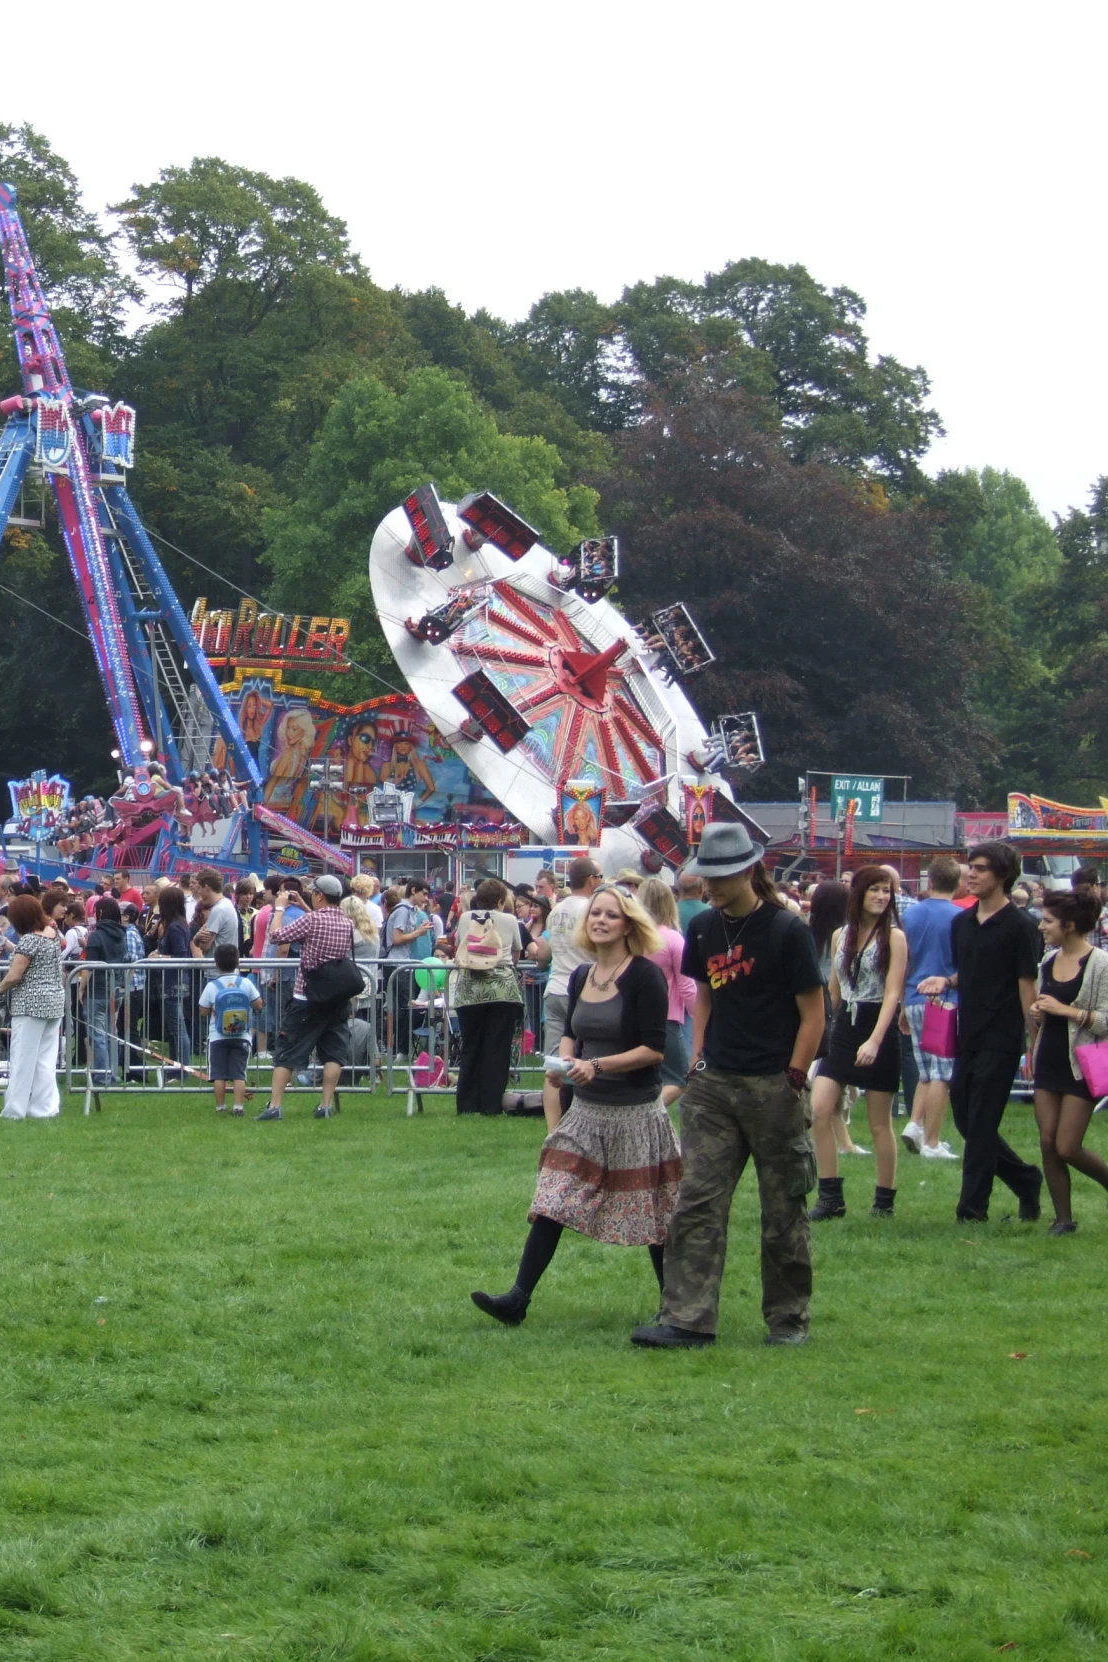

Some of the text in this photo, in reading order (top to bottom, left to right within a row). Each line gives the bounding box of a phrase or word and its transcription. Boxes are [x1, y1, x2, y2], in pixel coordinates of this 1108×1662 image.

[233, 597, 351, 663] ROLLER
[834, 779, 850, 790] EXIT
[707, 945, 743, 976] SIN
[710, 957, 755, 990] CITY
